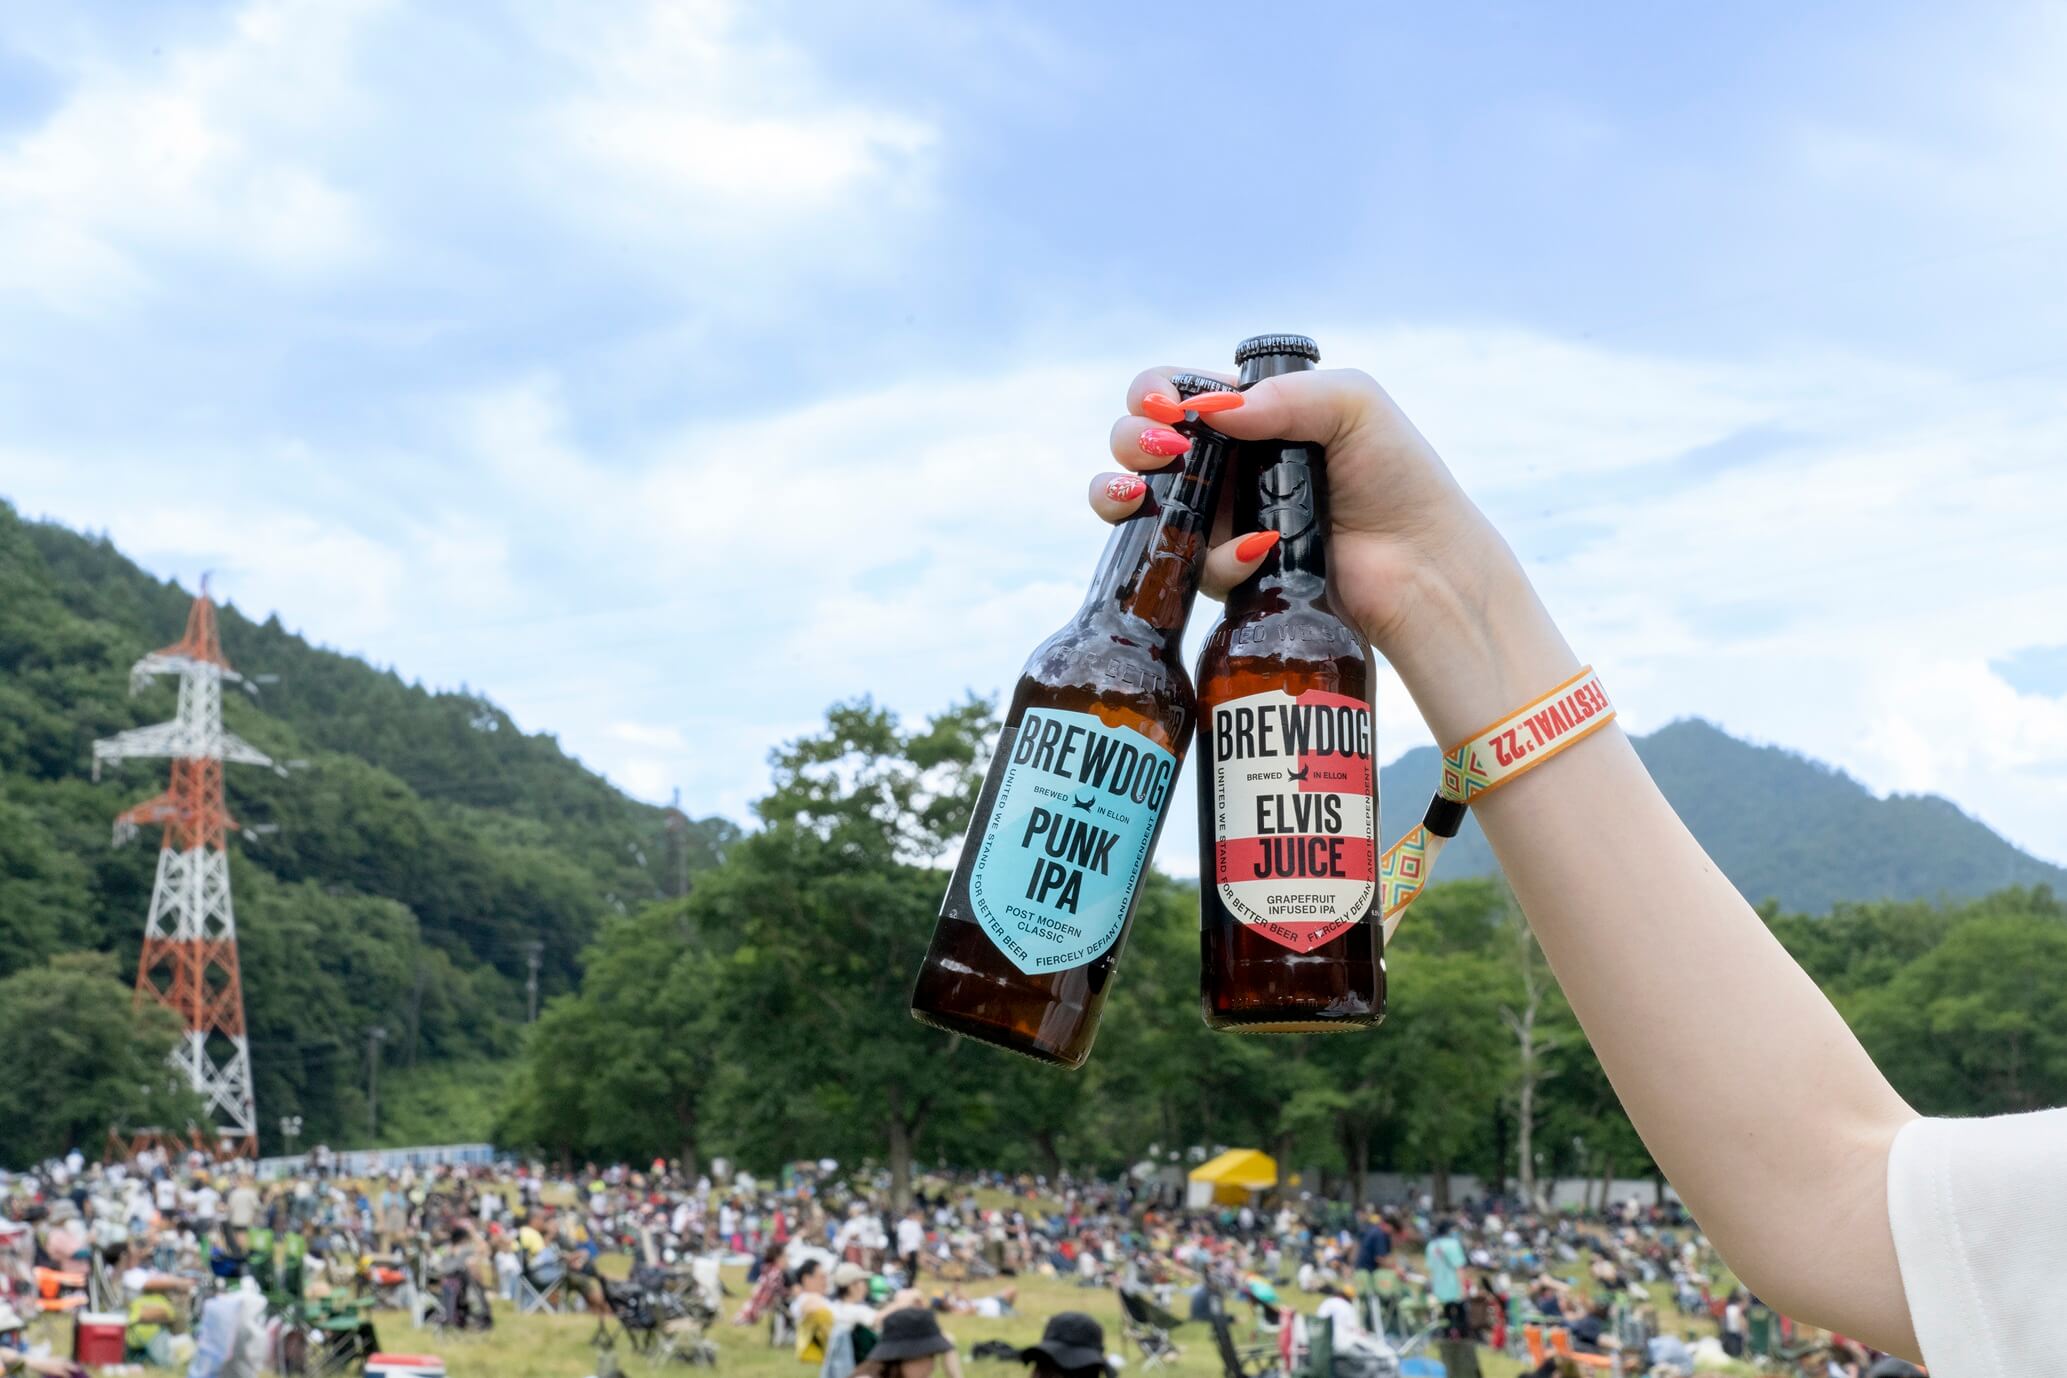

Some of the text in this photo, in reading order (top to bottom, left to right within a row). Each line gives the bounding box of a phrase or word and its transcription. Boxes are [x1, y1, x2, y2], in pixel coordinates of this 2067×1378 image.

[1217, 704, 1370, 763] BREWDOG
[1013, 714, 1171, 813] BREWDOG
[1246, 772, 1348, 782] BREWED IN ELLON
[1033, 785, 1130, 825] BREWED IN ELLON
[1256, 793, 1343, 835] ELVIS
[974, 768, 1028, 961] UNITED WE STAND FOR BETTER BEER
[1021, 806, 1121, 877] PUNK
[1217, 767, 1299, 942] UNITED WE STAND FOR BETTER BEER
[1253, 836, 1346, 879] JUICE
[1350, 878, 1373, 916] DEFIANT
[1364, 766, 1373, 848] INDEPENDENT
[1025, 857, 1084, 915] IPA
[1035, 816, 1155, 967] FIERCELY DEFIANT AND INDEPENDENT
[1266, 894, 1337, 904] GRAPEFRUIT
[1268, 905, 1337, 915] INFUSED IPA
[1005, 905, 1083, 938] POST MODERN
[1017, 921, 1065, 944] CLASSIC
